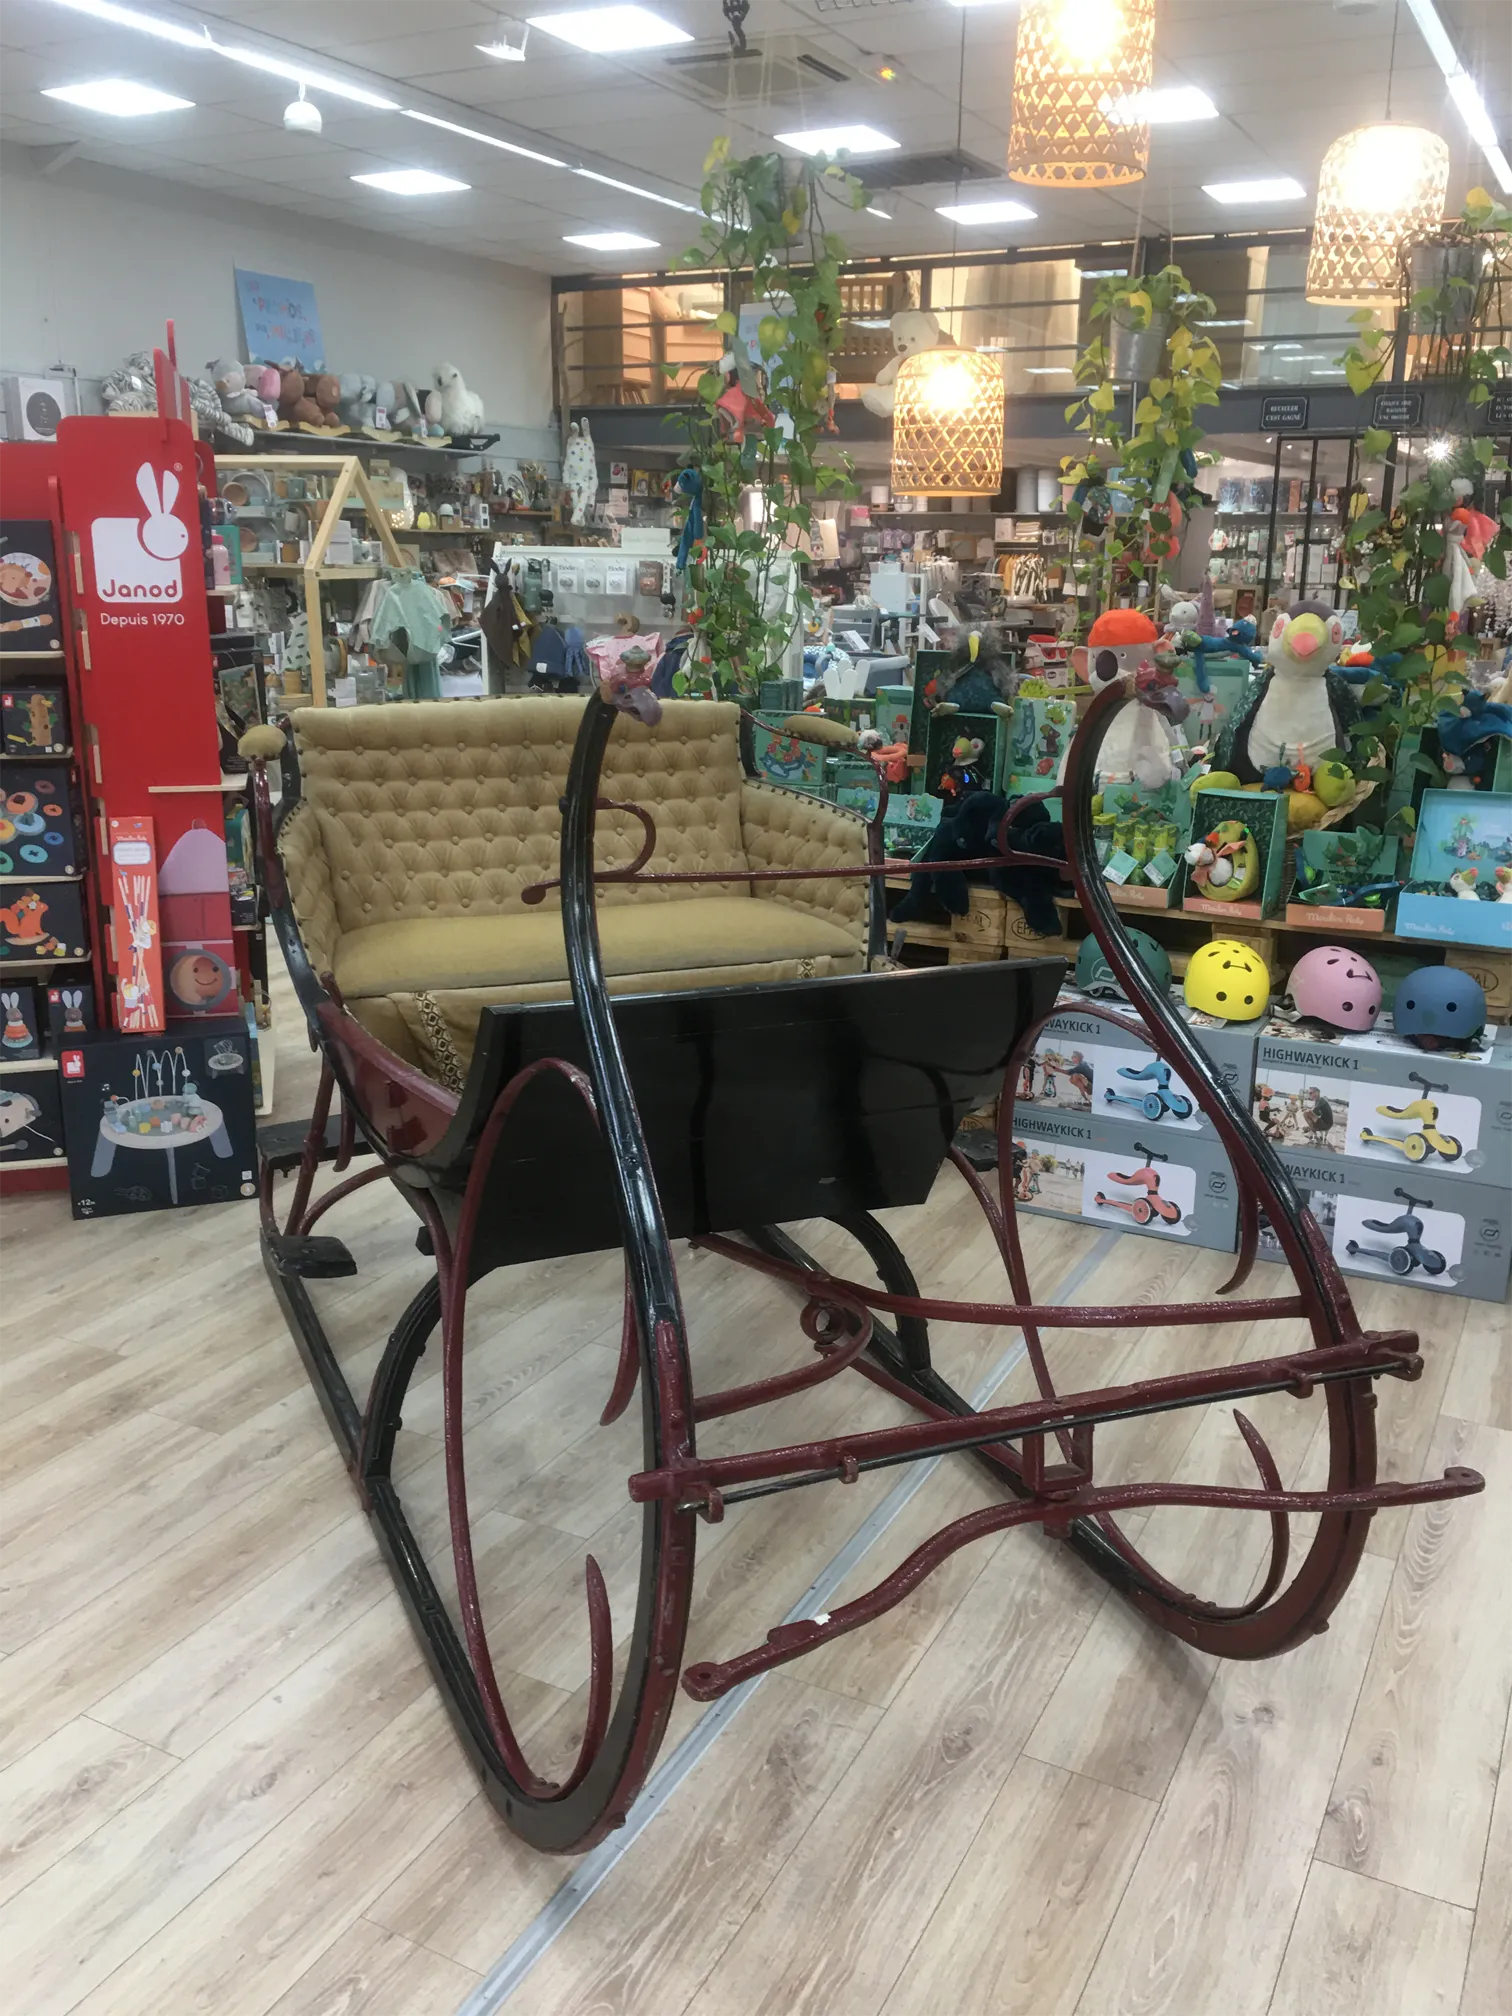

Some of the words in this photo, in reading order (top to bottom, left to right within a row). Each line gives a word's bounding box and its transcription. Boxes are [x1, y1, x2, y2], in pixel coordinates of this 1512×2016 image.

[102, 579, 178, 598] Janod
[100, 612, 149, 628] Depuis
[152, 613, 185, 626] 1970
[1046, 1018, 1094, 1034] WAYKICK
[1096, 1024, 1101, 1035] 1
[1262, 1047, 1351, 1069] HIGHWAYKICK
[1352, 1059, 1360, 1070] 1
[1086, 1129, 1092, 1140] 1
[1284, 1164, 1337, 1183] WAYKICK
[1339, 1173, 1345, 1184] 1
